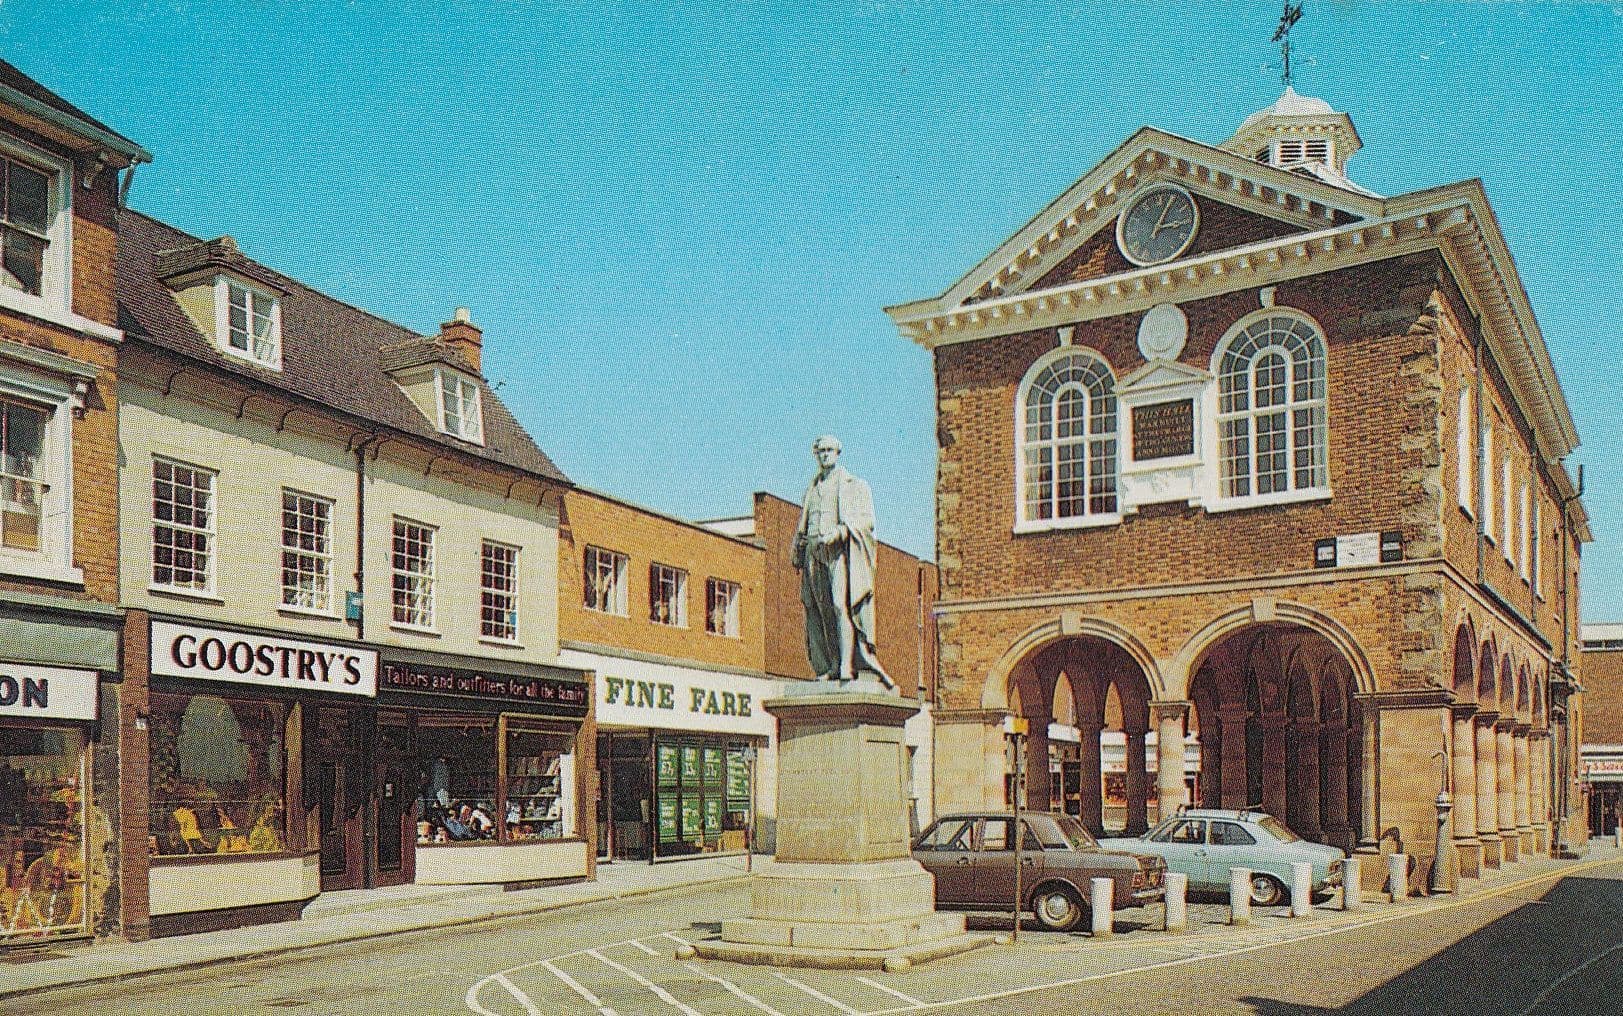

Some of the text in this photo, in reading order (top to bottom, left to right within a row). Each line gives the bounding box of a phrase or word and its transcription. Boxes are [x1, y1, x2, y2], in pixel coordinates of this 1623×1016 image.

[172, 635, 361, 685] GOOSTRY'S
[385, 666, 585, 704] Tailors and outfitters for all the family
[605, 677, 751, 717] FINE FARE
